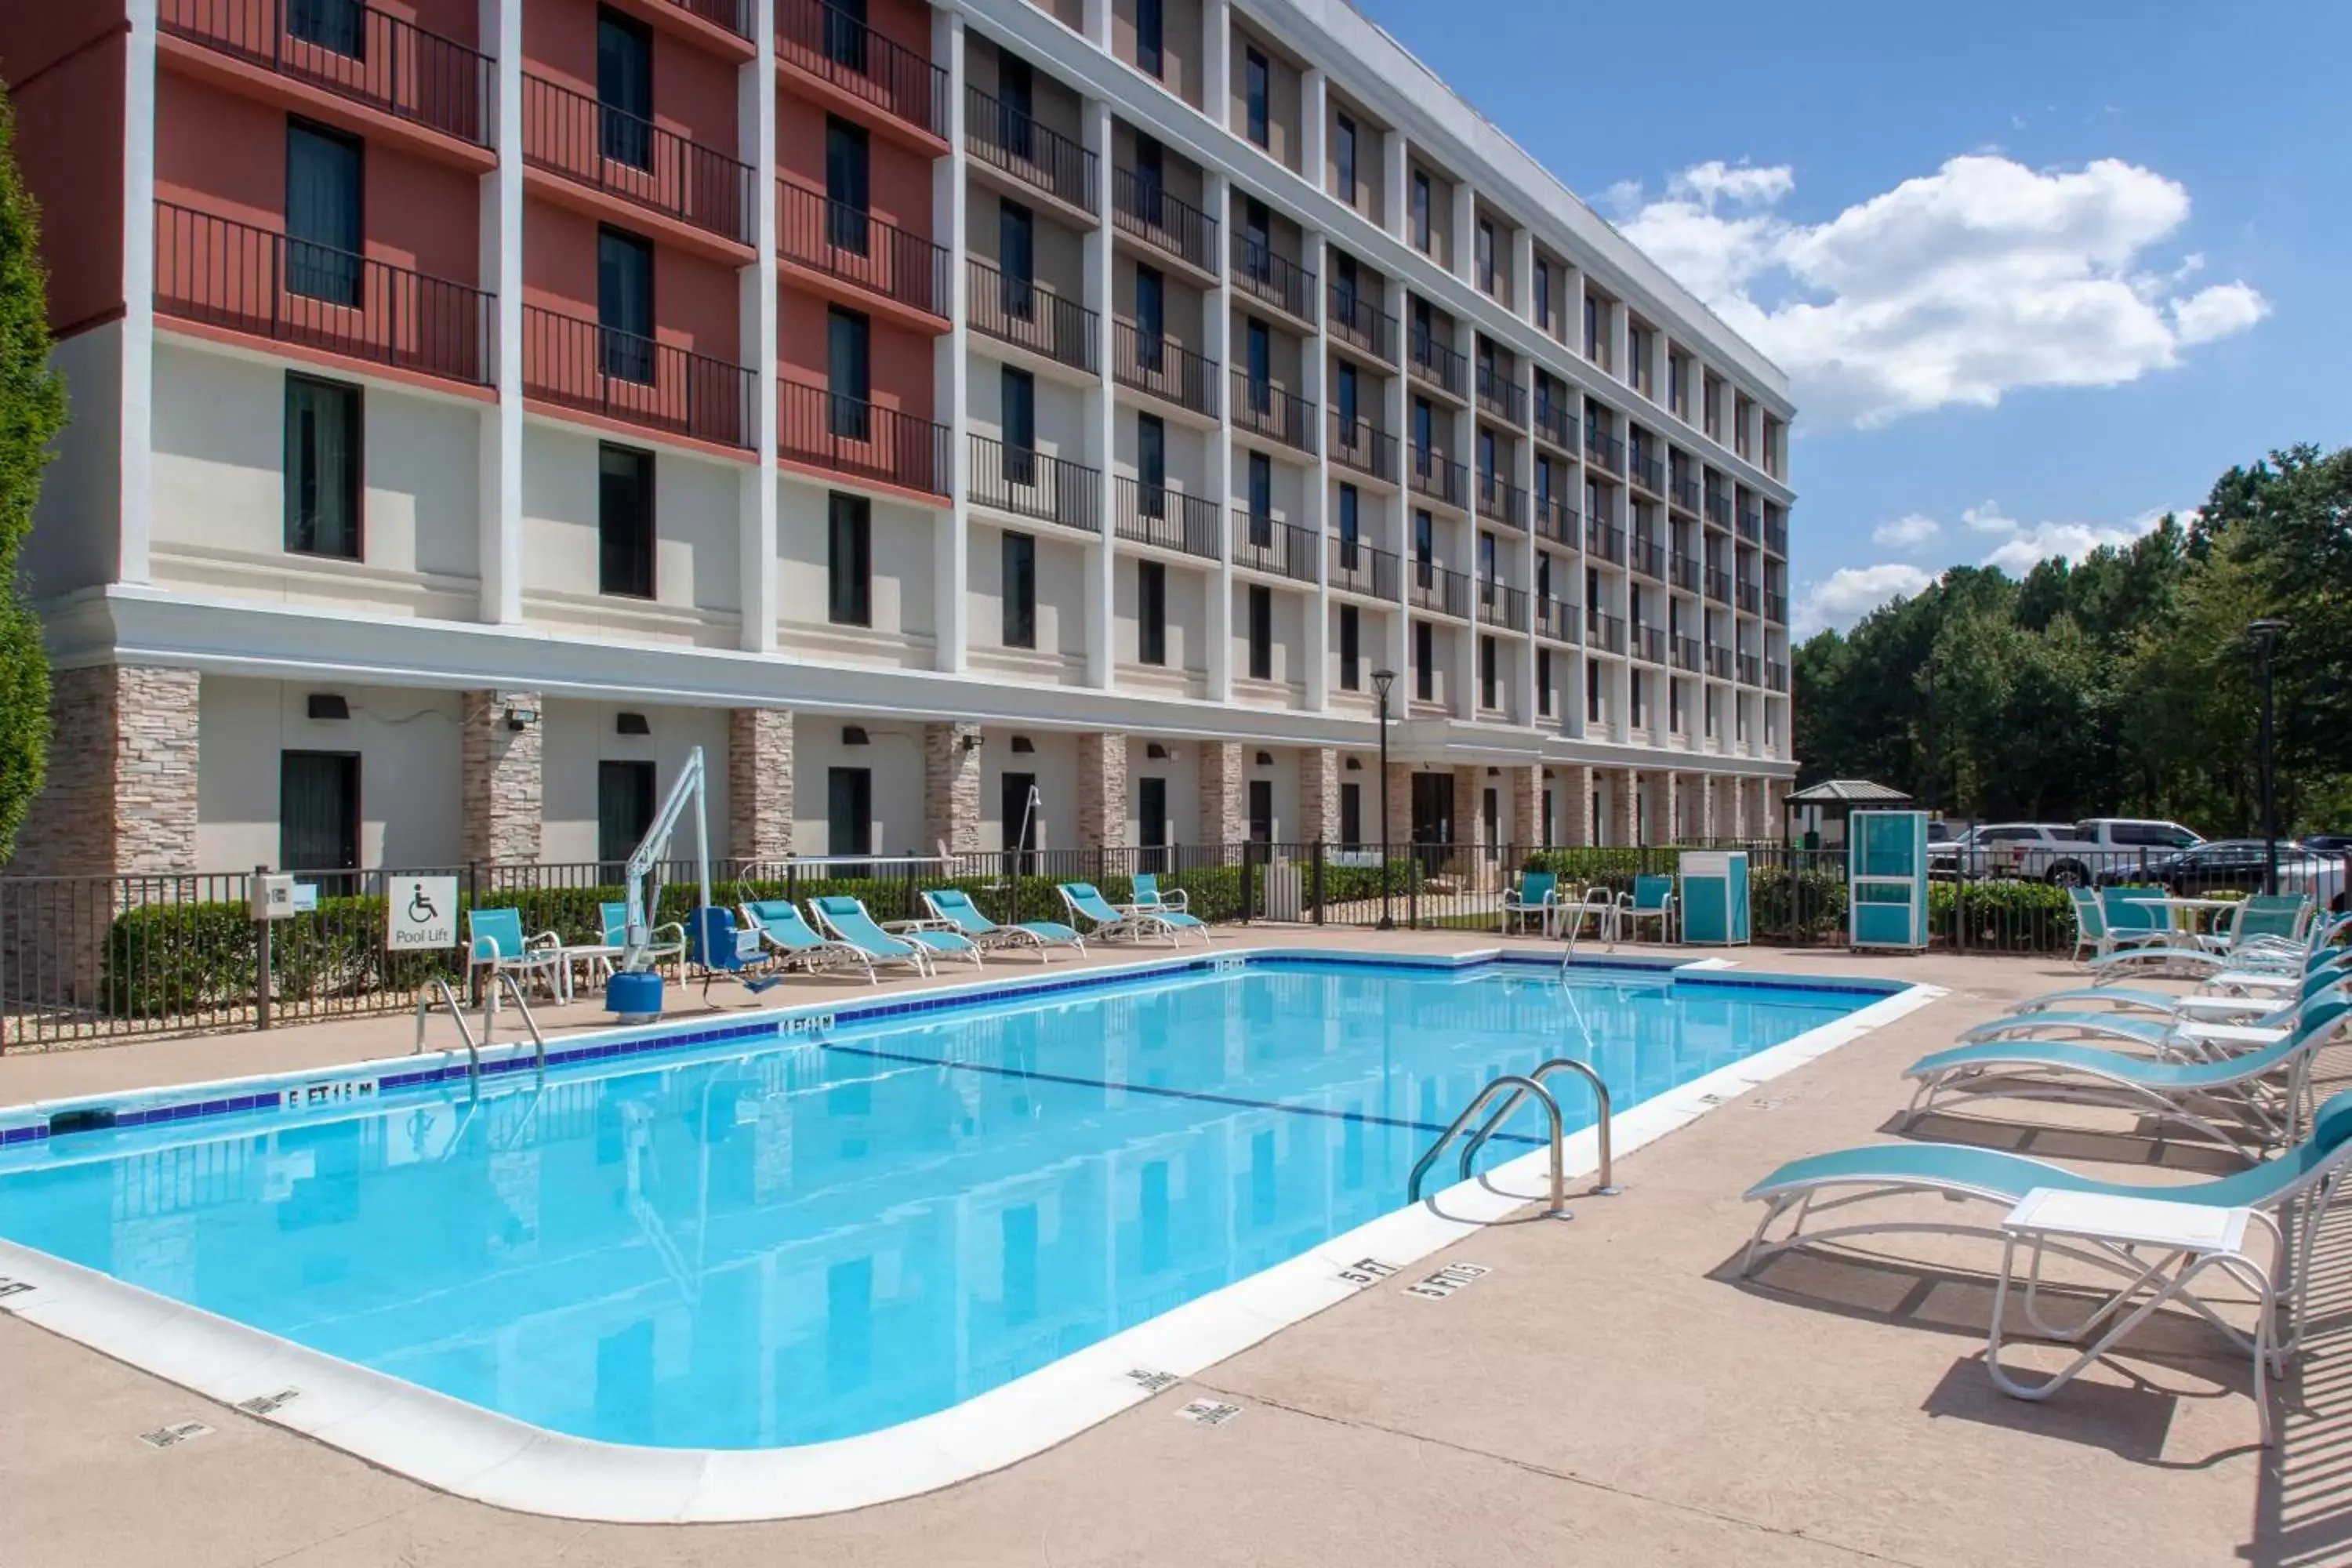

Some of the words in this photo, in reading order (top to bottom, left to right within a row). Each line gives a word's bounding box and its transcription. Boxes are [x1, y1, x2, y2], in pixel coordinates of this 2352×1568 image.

[396, 930, 424, 943] Pool
[429, 928, 448, 942] Lift
[1352, 1258, 1398, 1276] FT
[1338, 1271, 1370, 1283] 5
[1423, 1272, 1468, 1288] FT
[1406, 1286, 1446, 1297] 5
